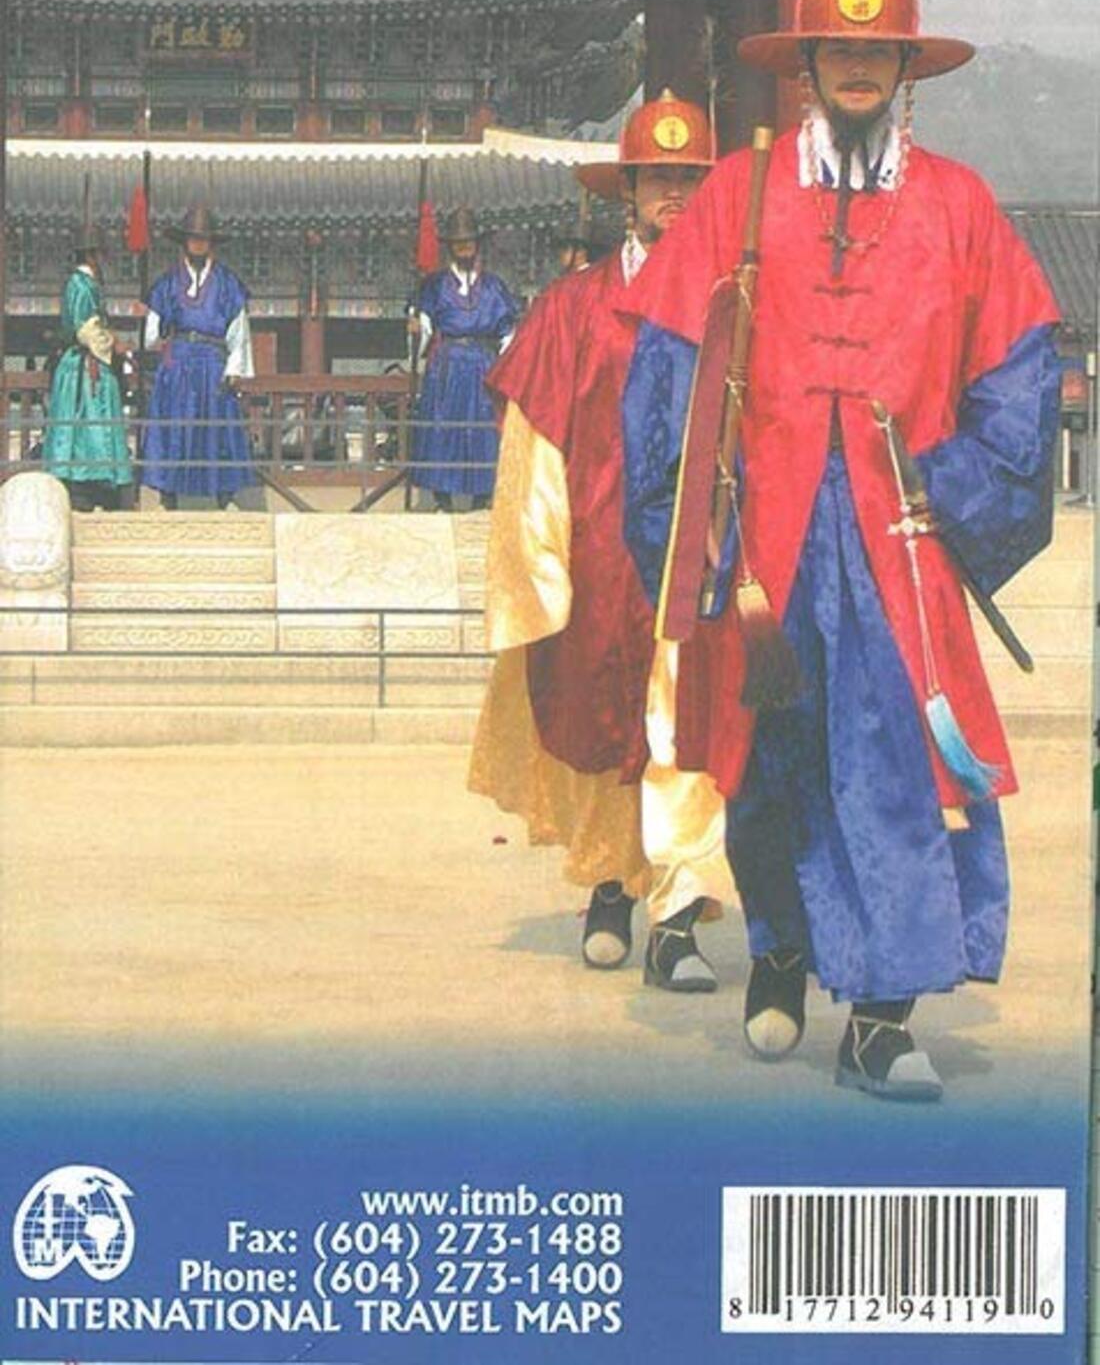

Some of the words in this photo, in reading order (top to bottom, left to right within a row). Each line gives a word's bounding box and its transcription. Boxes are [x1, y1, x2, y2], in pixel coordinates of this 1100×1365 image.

[360, 1184, 623, 1217] www.itmb.com
[226, 1221, 298, 1254] Fax:
[312, 1221, 421, 1259] (604)
[434, 1222, 622, 1256] 273-1488
[179, 1259, 298, 1292] Phone:
[312, 1259, 421, 1298] (604)
[434, 1260, 623, 1295] 273-1400
[16, 1299, 342, 1333] INTERNATIONAL
[354, 1299, 502, 1333] TRAVEL
[514, 1300, 622, 1334] MAPS
[728, 1297, 743, 1319] 8
[784, 1299, 882, 1323] 17712
[899, 1298, 1000, 1323] 94119
[1039, 1298, 1055, 1320] 0
